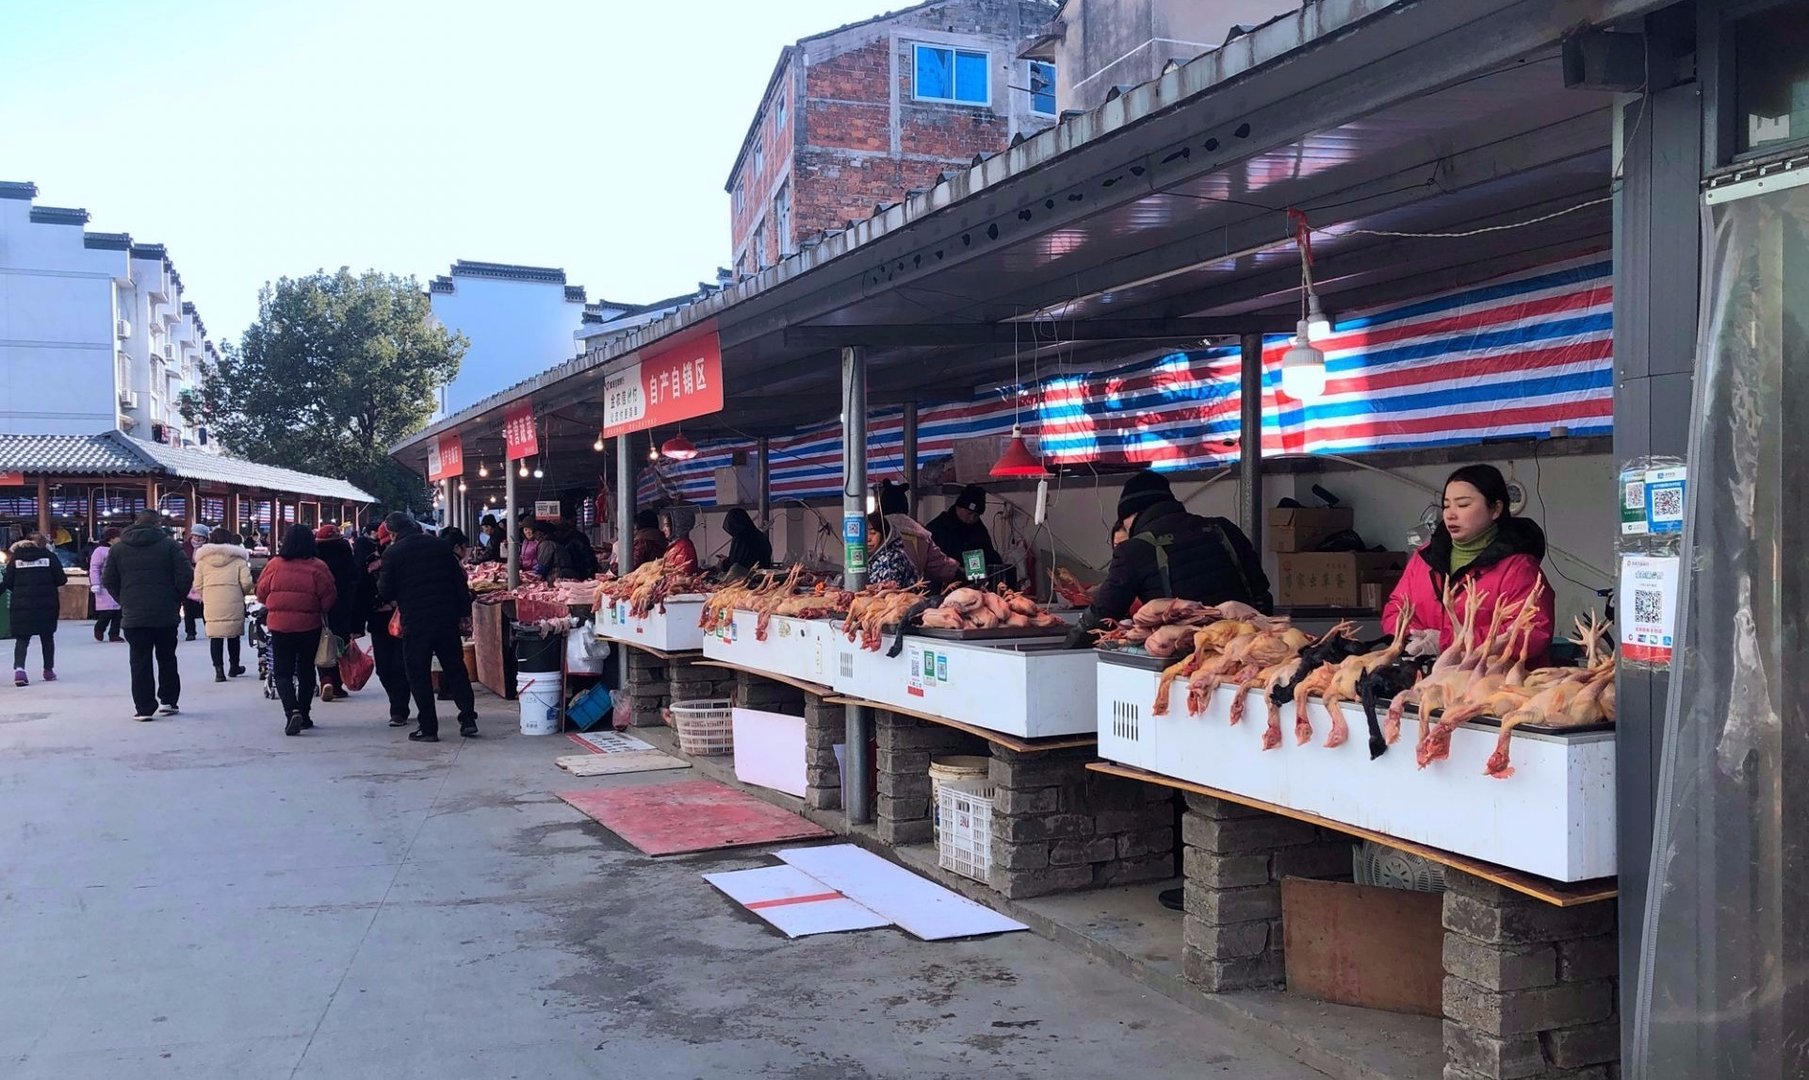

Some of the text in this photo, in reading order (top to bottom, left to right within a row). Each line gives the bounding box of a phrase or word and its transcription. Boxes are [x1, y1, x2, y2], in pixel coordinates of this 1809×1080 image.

[650, 357, 707, 405] 自产自销区
